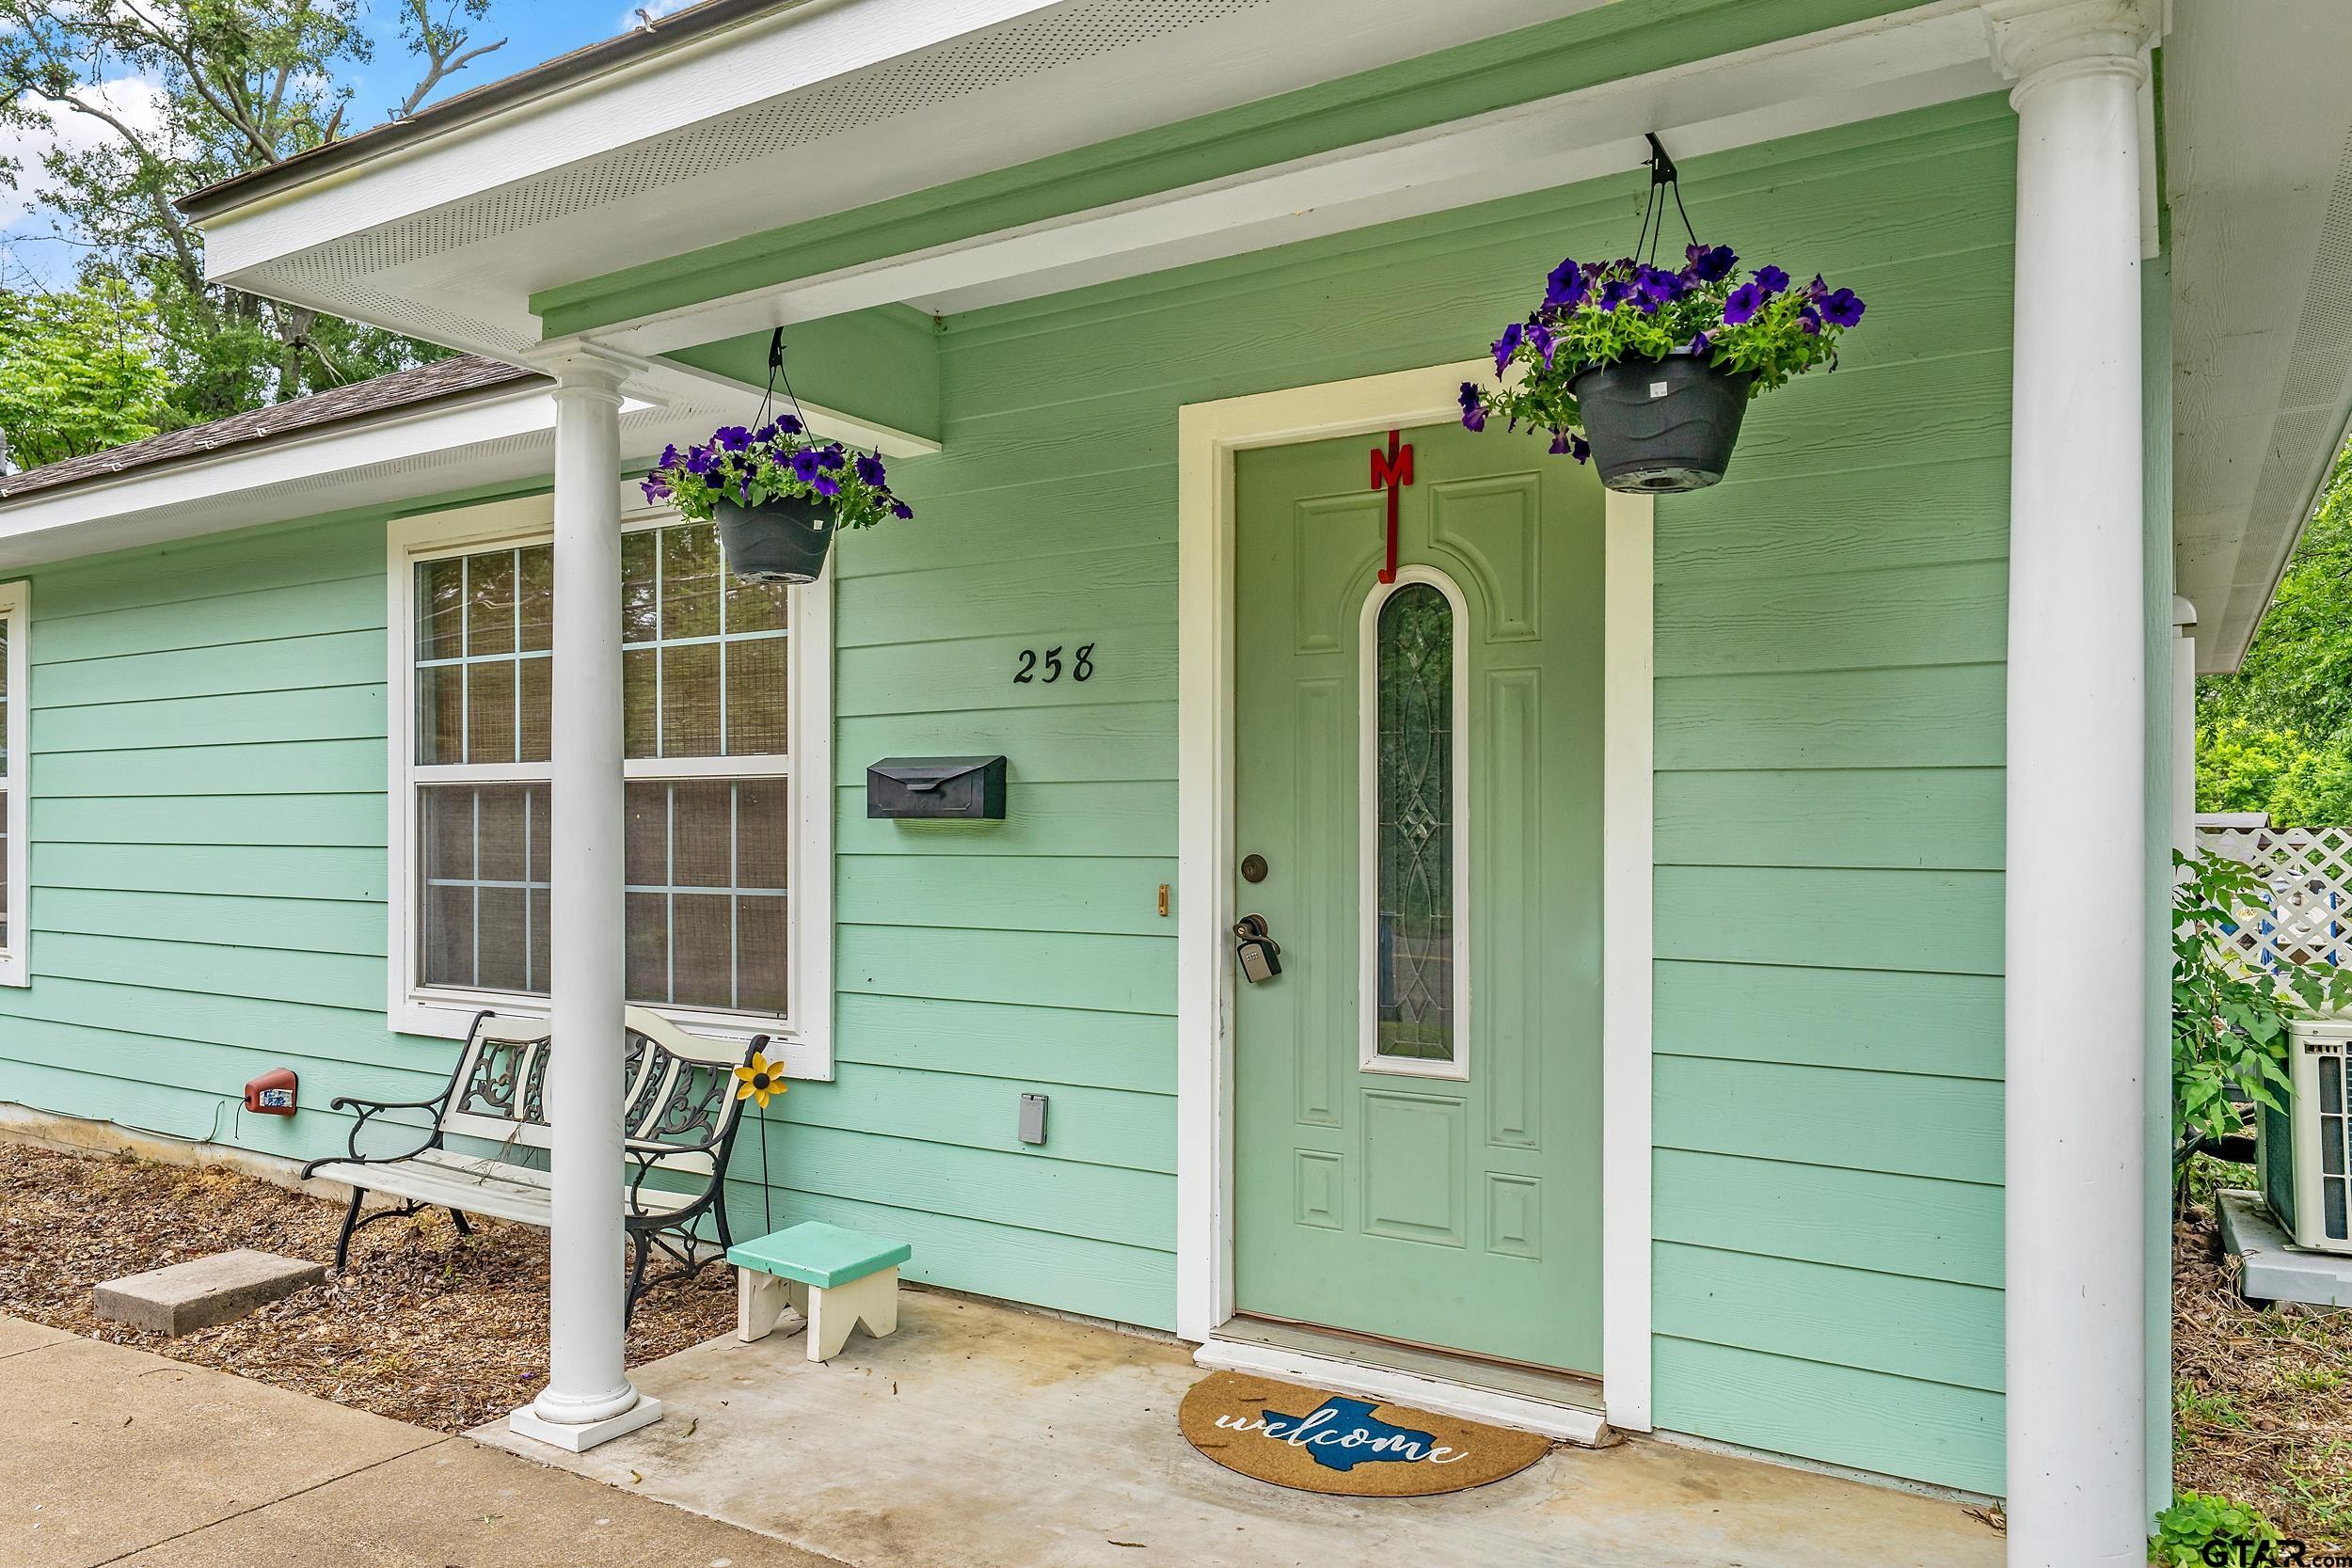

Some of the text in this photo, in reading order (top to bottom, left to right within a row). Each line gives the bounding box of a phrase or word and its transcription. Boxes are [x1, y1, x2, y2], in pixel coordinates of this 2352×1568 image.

[1371, 444, 1413, 490] M
[1013, 642, 1094, 683] 258
[1215, 1408, 1469, 1464] welcome
